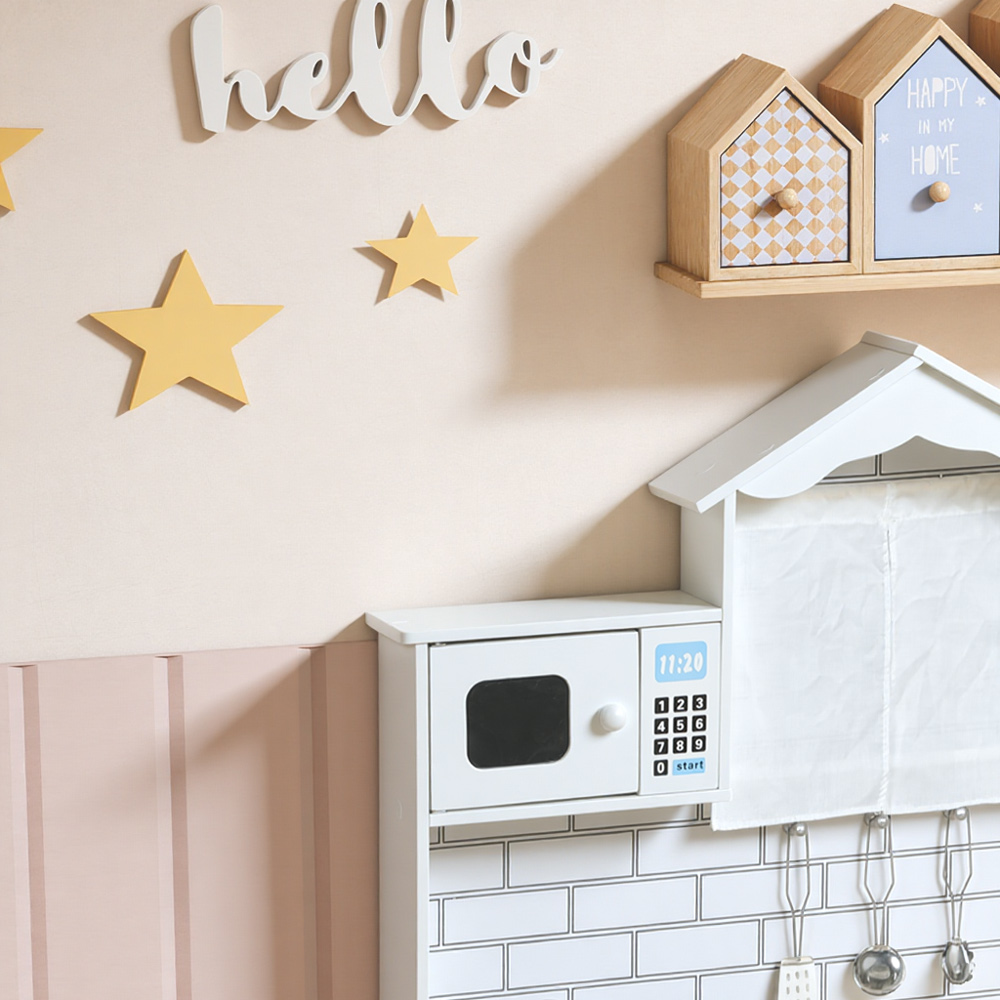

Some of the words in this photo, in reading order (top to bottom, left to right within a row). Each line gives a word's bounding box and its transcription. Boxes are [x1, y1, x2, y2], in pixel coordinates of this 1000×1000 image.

[191, 0, 563, 134] hello
[907, 77, 968, 109] HAPPY
[918, 119, 930, 134] IN
[938, 118, 955, 132] MY
[911, 144, 960, 175] HOME
[660, 652, 703, 675] 11:20
[658, 700, 665, 711] 1
[676, 699, 684, 711] 2
[696, 697, 703, 709] 3
[657, 721, 665, 732] 4
[676, 720, 684, 731] 5
[695, 718, 703, 729] 6
[657, 742, 665, 753] 7
[676, 740, 684, 751] 8
[695, 739, 703, 750] 9
[657, 762, 665, 773] 0
[676, 760, 704, 772] start
